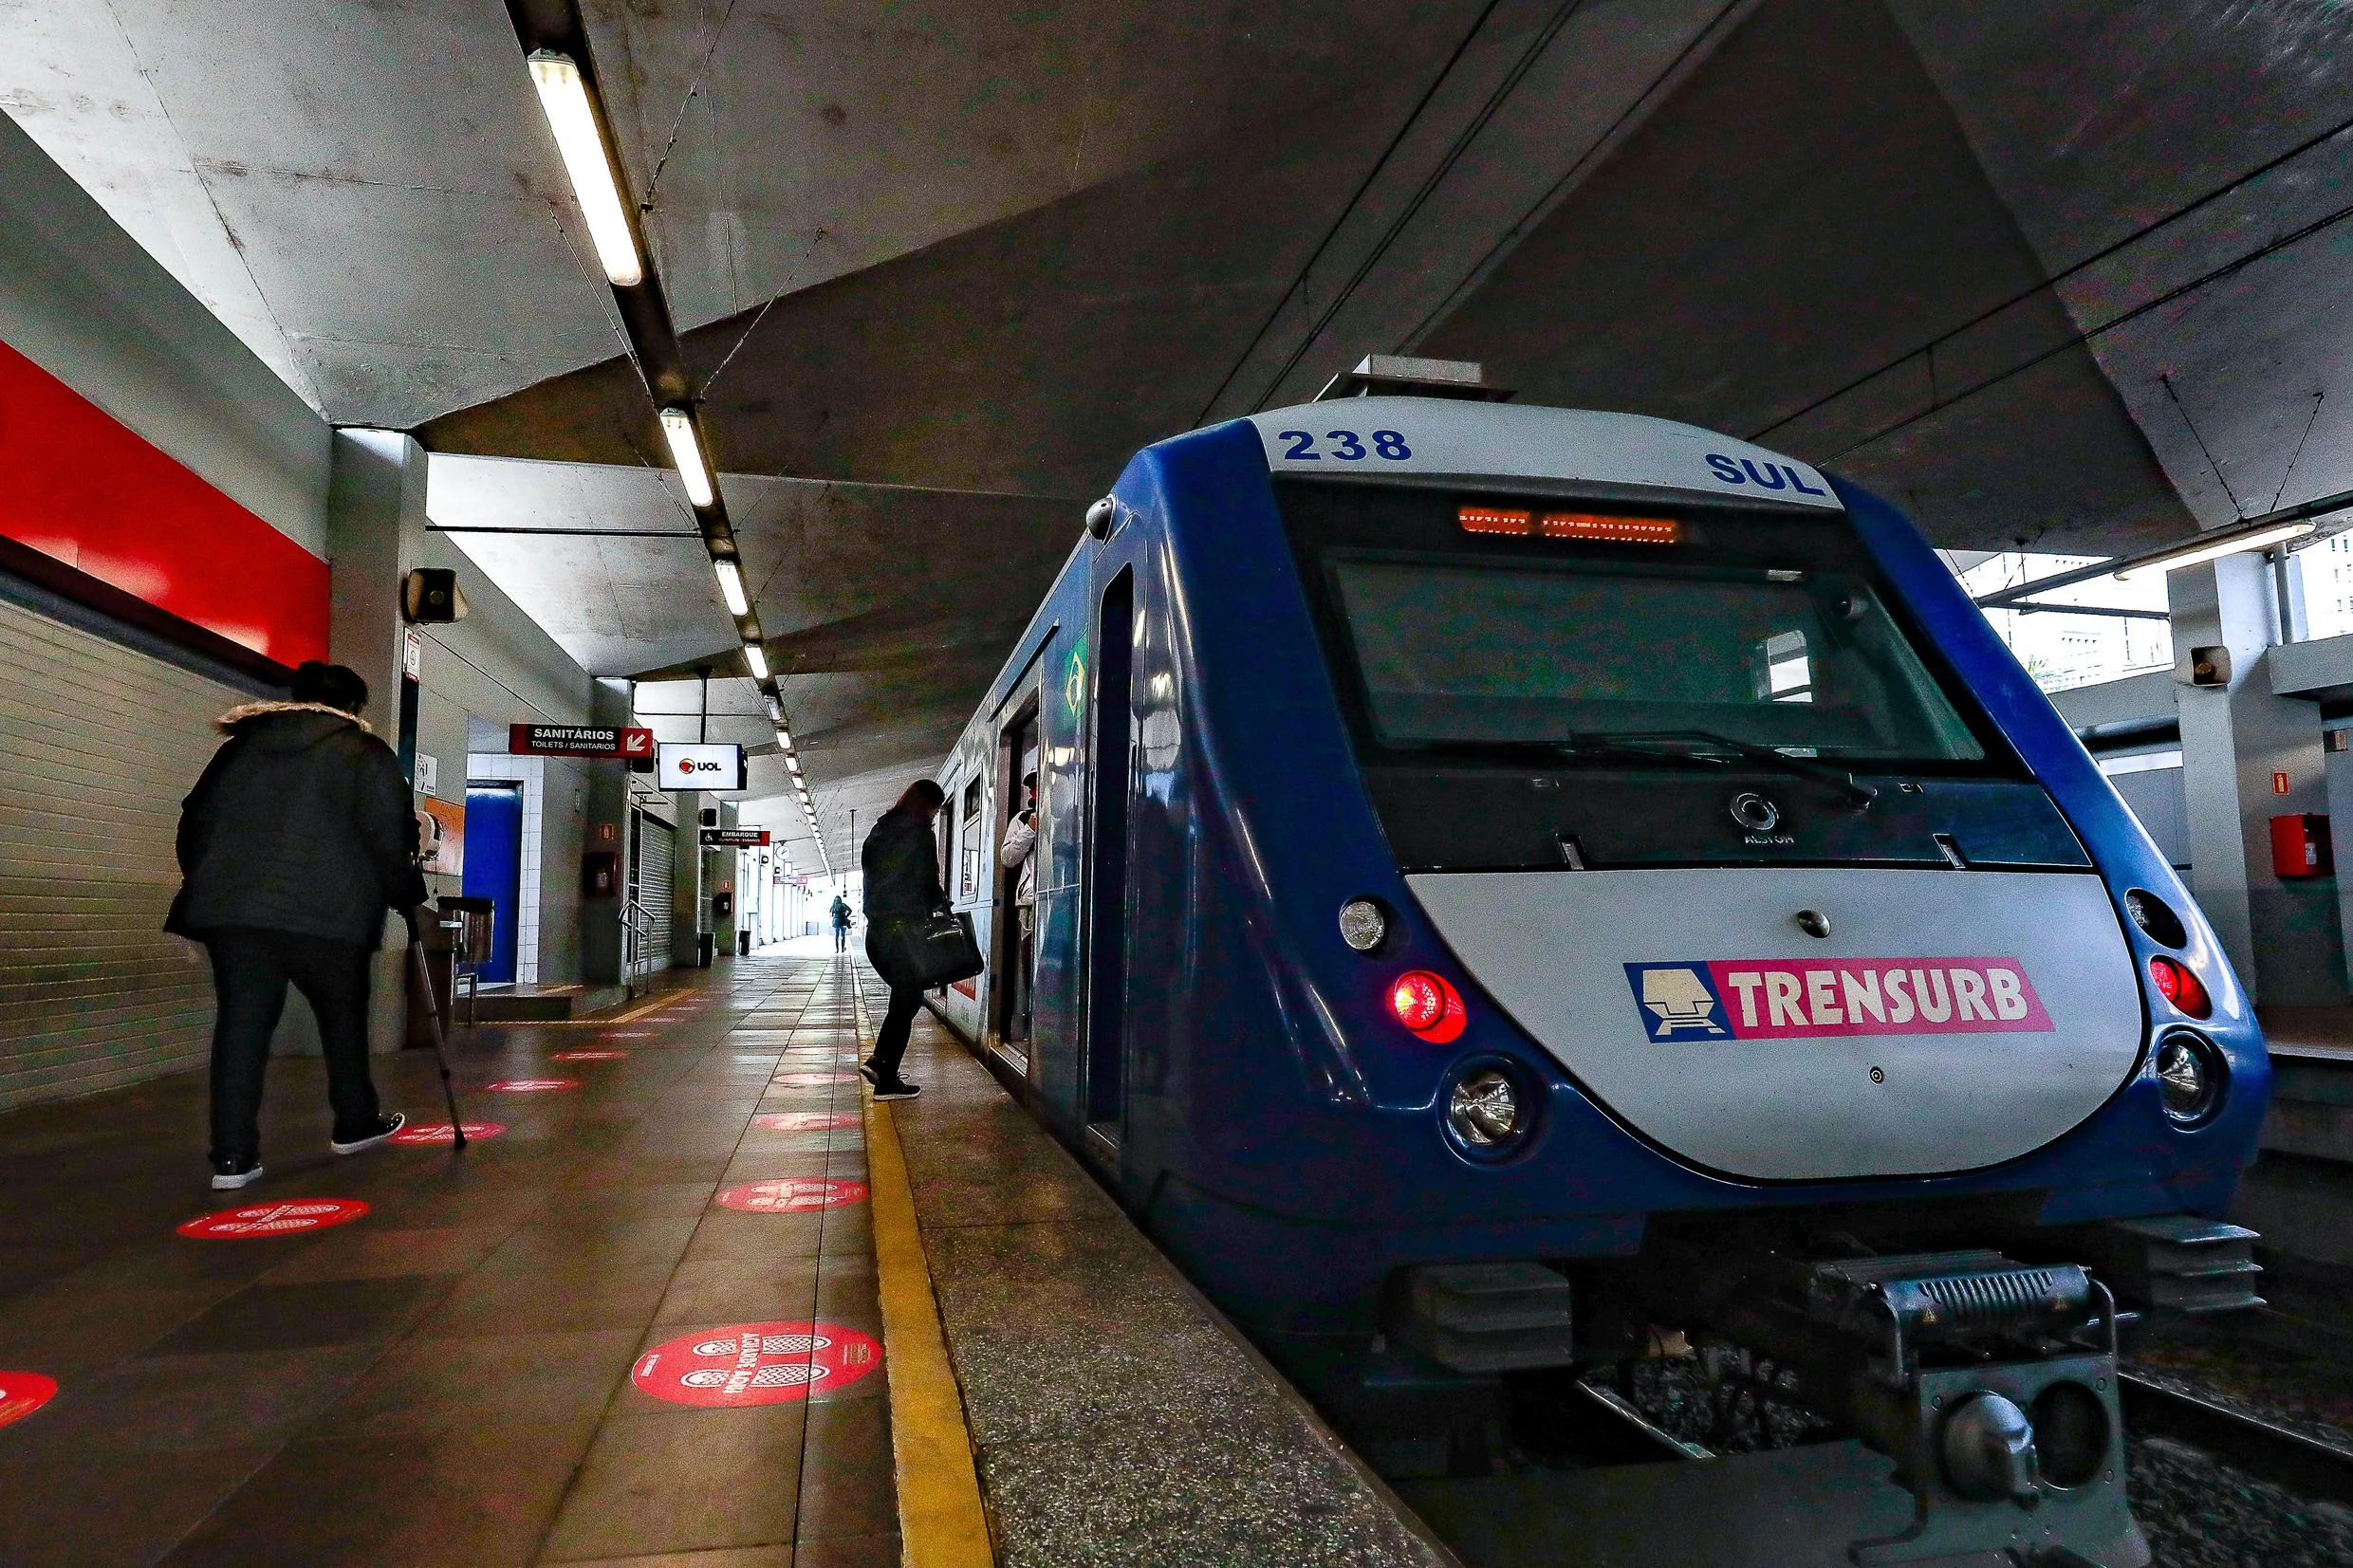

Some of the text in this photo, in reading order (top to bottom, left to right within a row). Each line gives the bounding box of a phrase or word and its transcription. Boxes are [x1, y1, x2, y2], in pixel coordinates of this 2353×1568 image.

[1278, 430, 1412, 460] 238
[1705, 452, 1826, 496] SUL
[531, 740, 564, 748] TOILETS
[569, 742, 616, 750] SANITARIOS
[534, 728, 614, 740] SANITÁRIOS
[697, 762, 721, 771] UOL
[1728, 968, 2029, 1028] TRENSURB
[736, 1333, 760, 1369] AGUARDE
